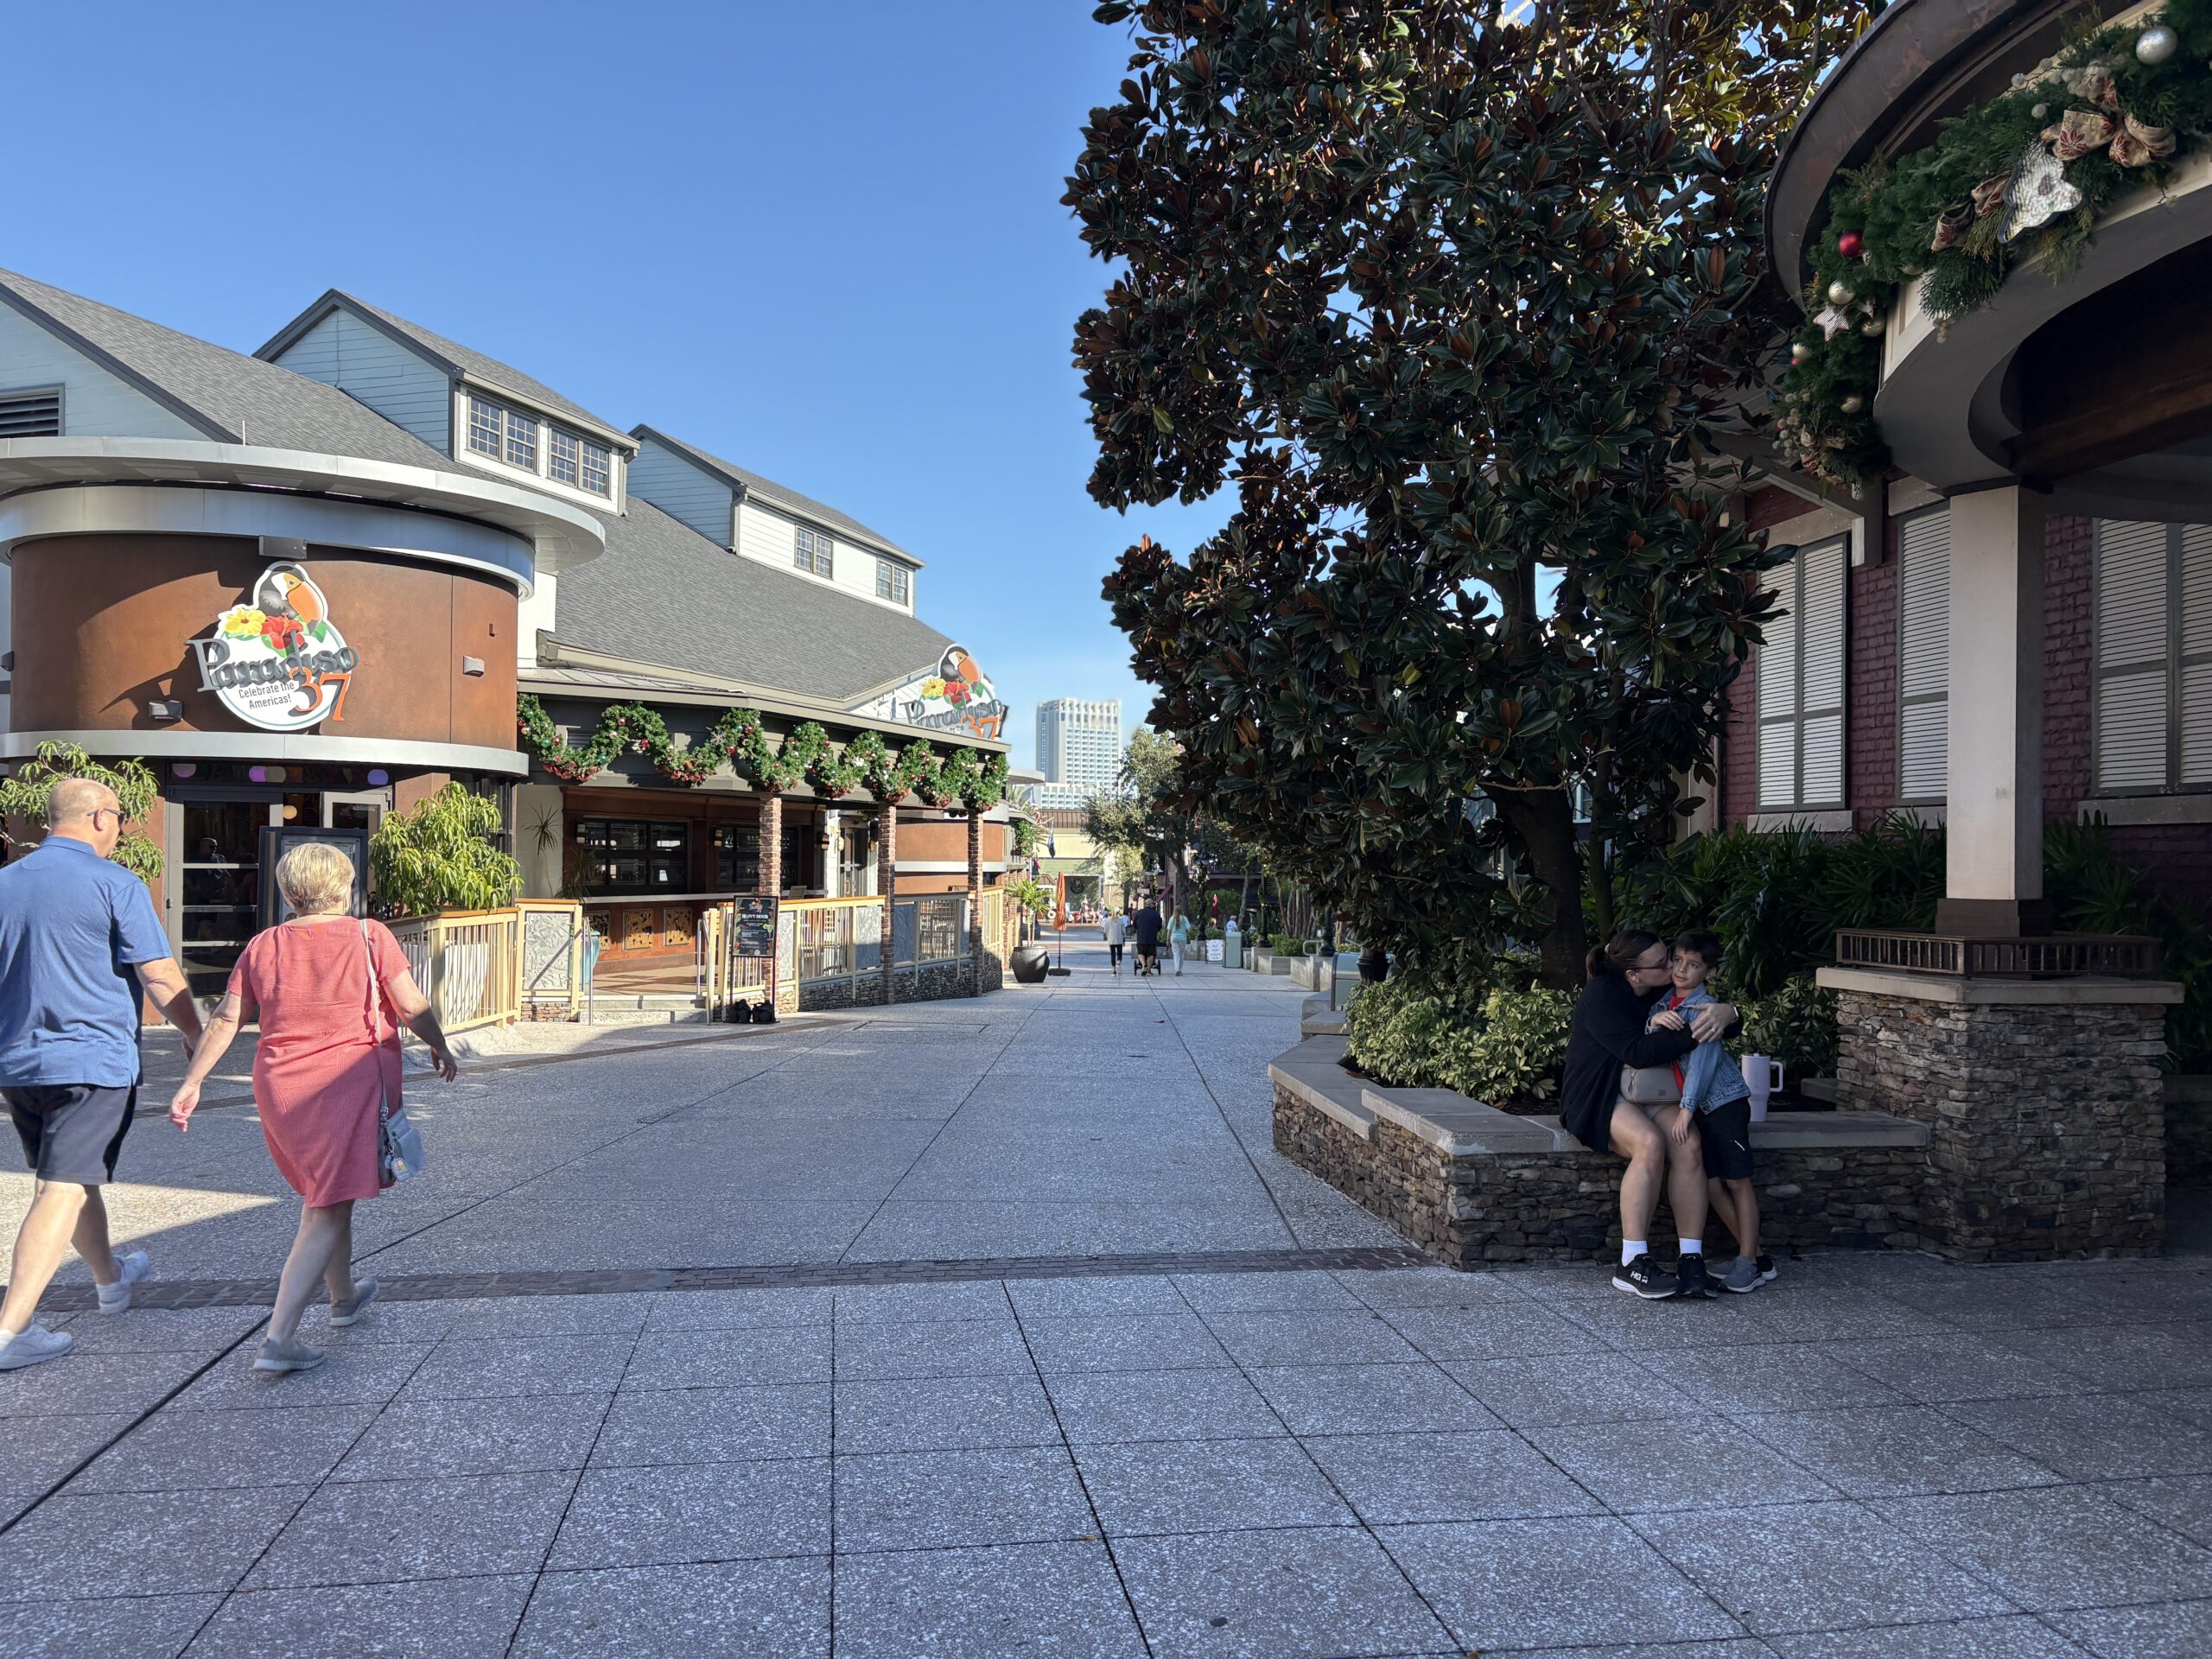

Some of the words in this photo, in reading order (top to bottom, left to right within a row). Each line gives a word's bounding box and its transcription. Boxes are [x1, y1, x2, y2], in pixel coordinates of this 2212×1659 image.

[183, 629, 359, 692] Paradiso
[238, 683, 280, 699] Celebrate
[280, 681, 295, 691] the
[249, 694, 292, 709] Americas!
[289, 666, 351, 721] 37
[899, 690, 1003, 728] Paradiso
[960, 715, 998, 740] 37
